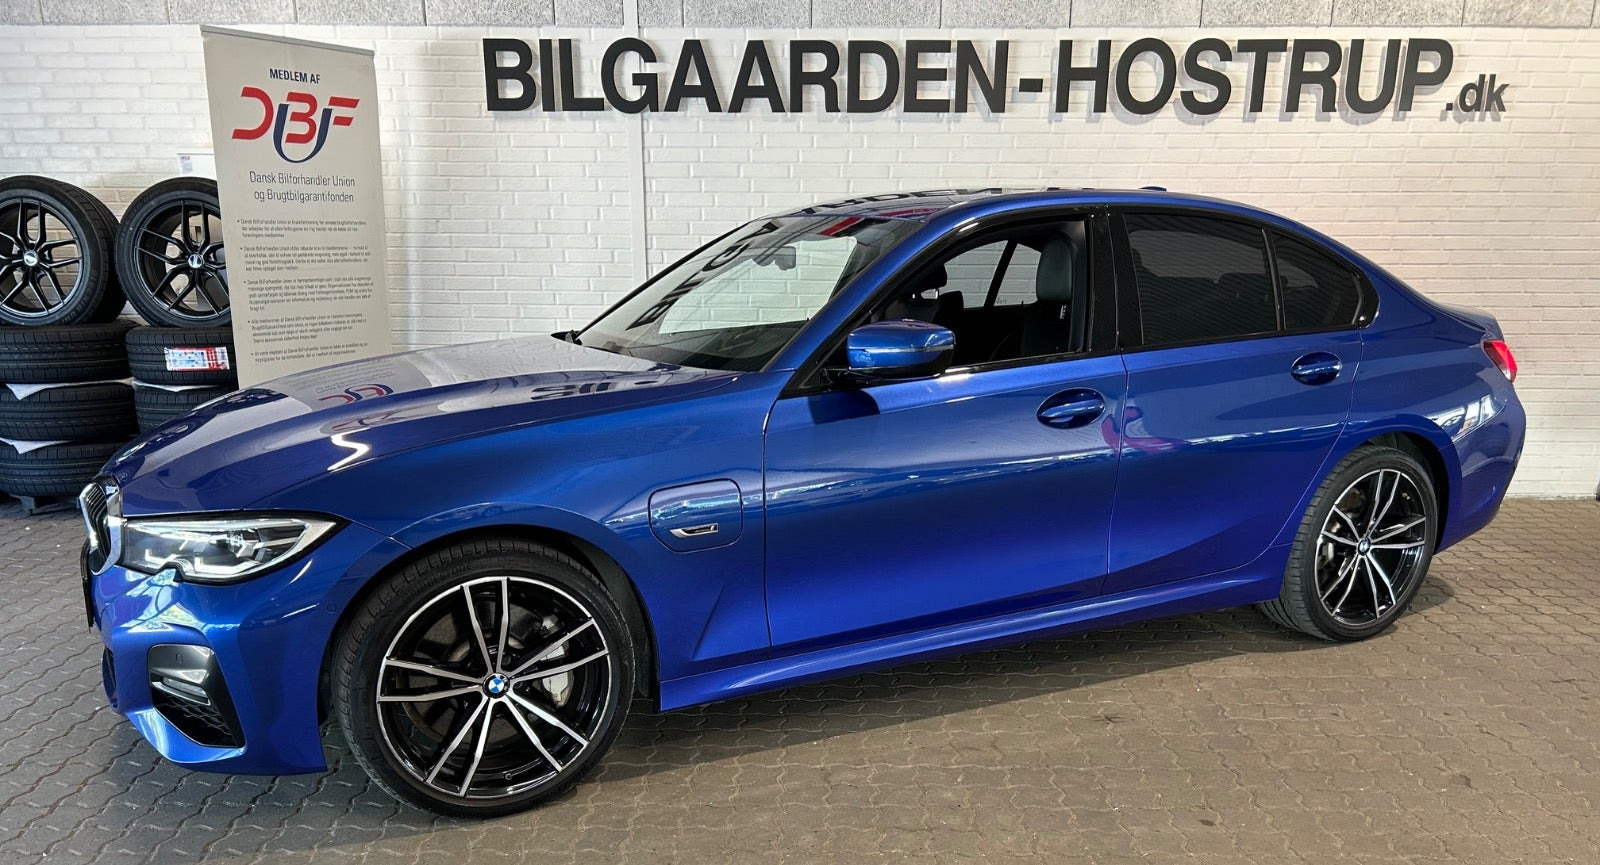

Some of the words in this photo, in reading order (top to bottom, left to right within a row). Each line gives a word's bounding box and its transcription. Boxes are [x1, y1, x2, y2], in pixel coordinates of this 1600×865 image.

[269, 68, 308, 84] MEDLEM
[310, 74, 321, 85] AF
[249, 171, 276, 184] Dansk
[278, 173, 330, 187] Bilforhandler
[332, 175, 355, 187] Union
[254, 190, 265, 202] og
[267, 189, 354, 204] Brugtbilgarantifonden
